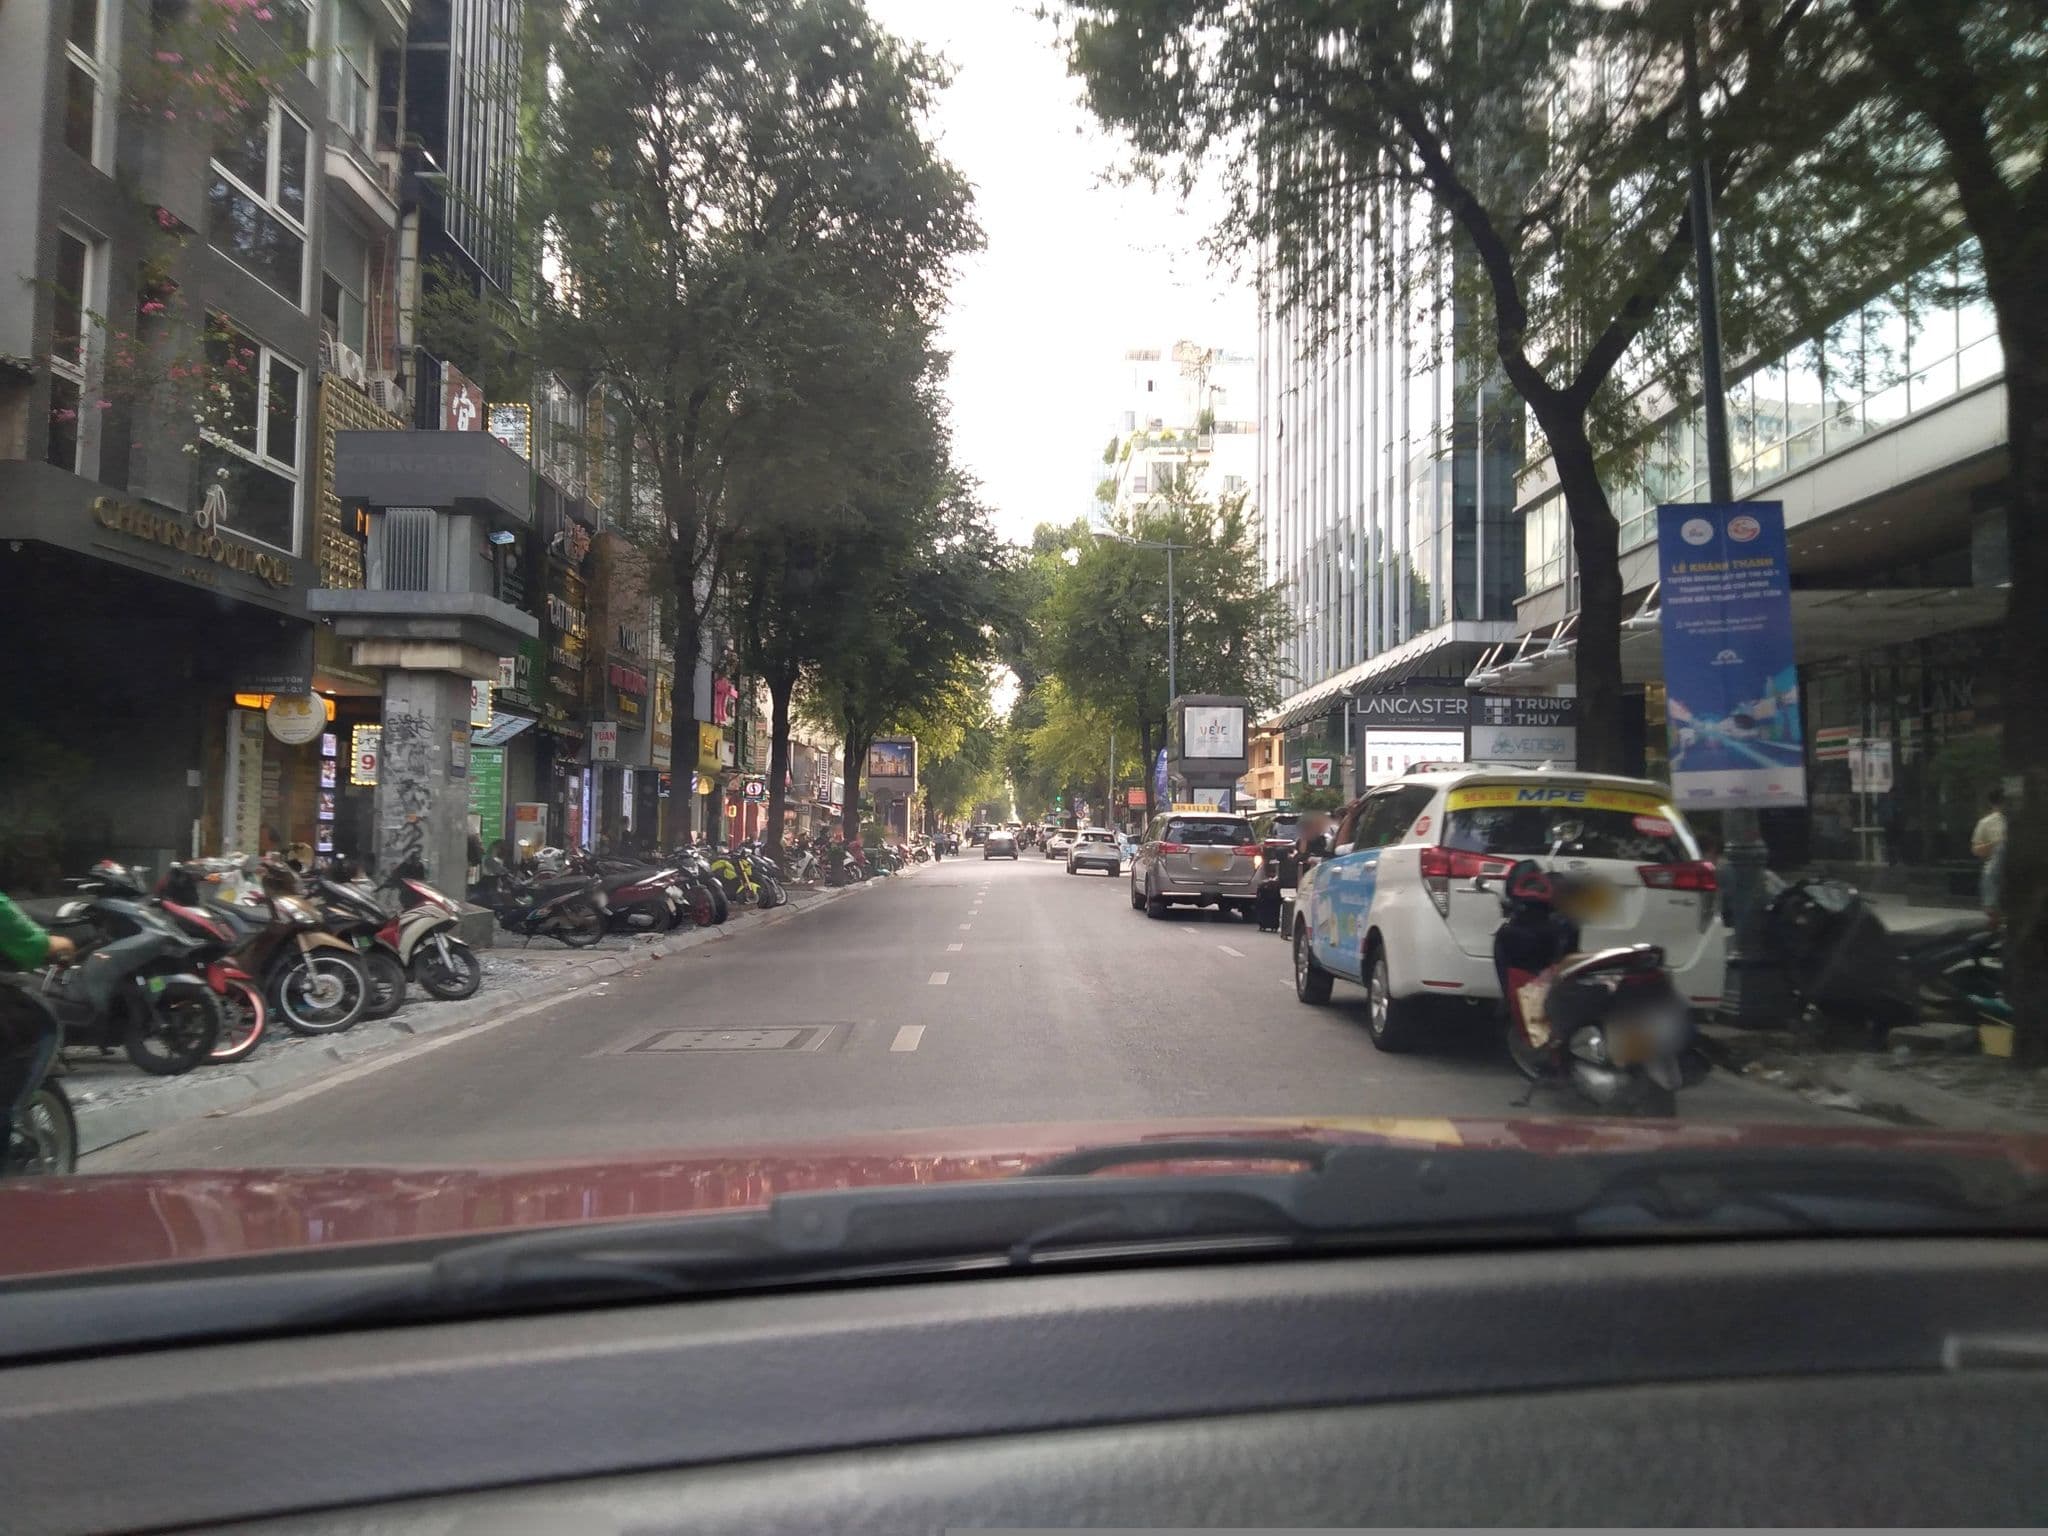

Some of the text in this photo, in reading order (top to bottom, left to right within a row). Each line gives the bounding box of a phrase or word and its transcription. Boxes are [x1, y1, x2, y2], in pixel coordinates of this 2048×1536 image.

[1356, 698, 1468, 714] LANCASTER
[1516, 698, 1572, 710] TRUNG
[1515, 713, 1561, 725] THUY
[594, 731, 616, 741] YUAN
[361, 754, 376, 770] 9
[1311, 762, 1329, 774] 7
[1516, 789, 1586, 803] MPE
